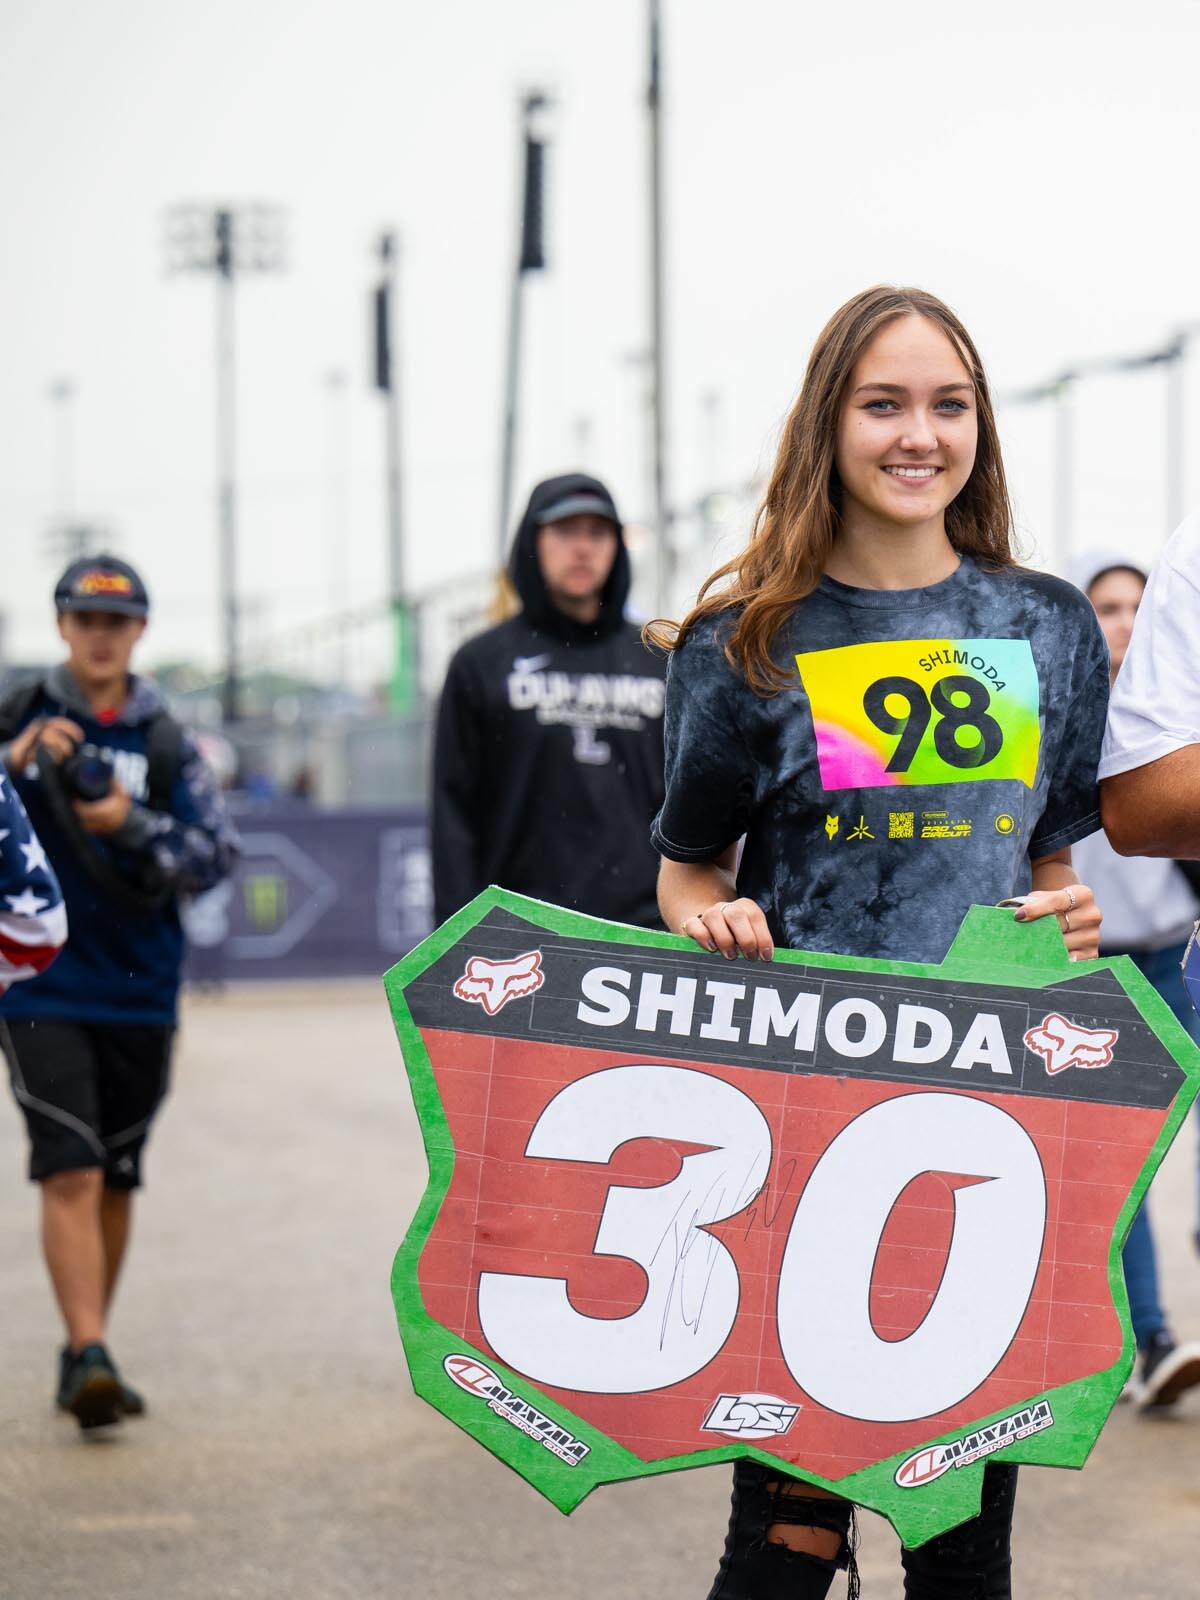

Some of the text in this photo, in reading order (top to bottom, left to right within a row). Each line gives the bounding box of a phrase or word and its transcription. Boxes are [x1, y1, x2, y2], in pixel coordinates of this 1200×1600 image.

[918, 650, 1007, 692] SHIMODA
[863, 675, 1003, 773] 98
[576, 965, 1013, 1075] SHIMODA
[477, 1063, 1048, 1423] 30
[542, 1438, 579, 1467] OILS
[1016, 1418, 1053, 1440] OILS
